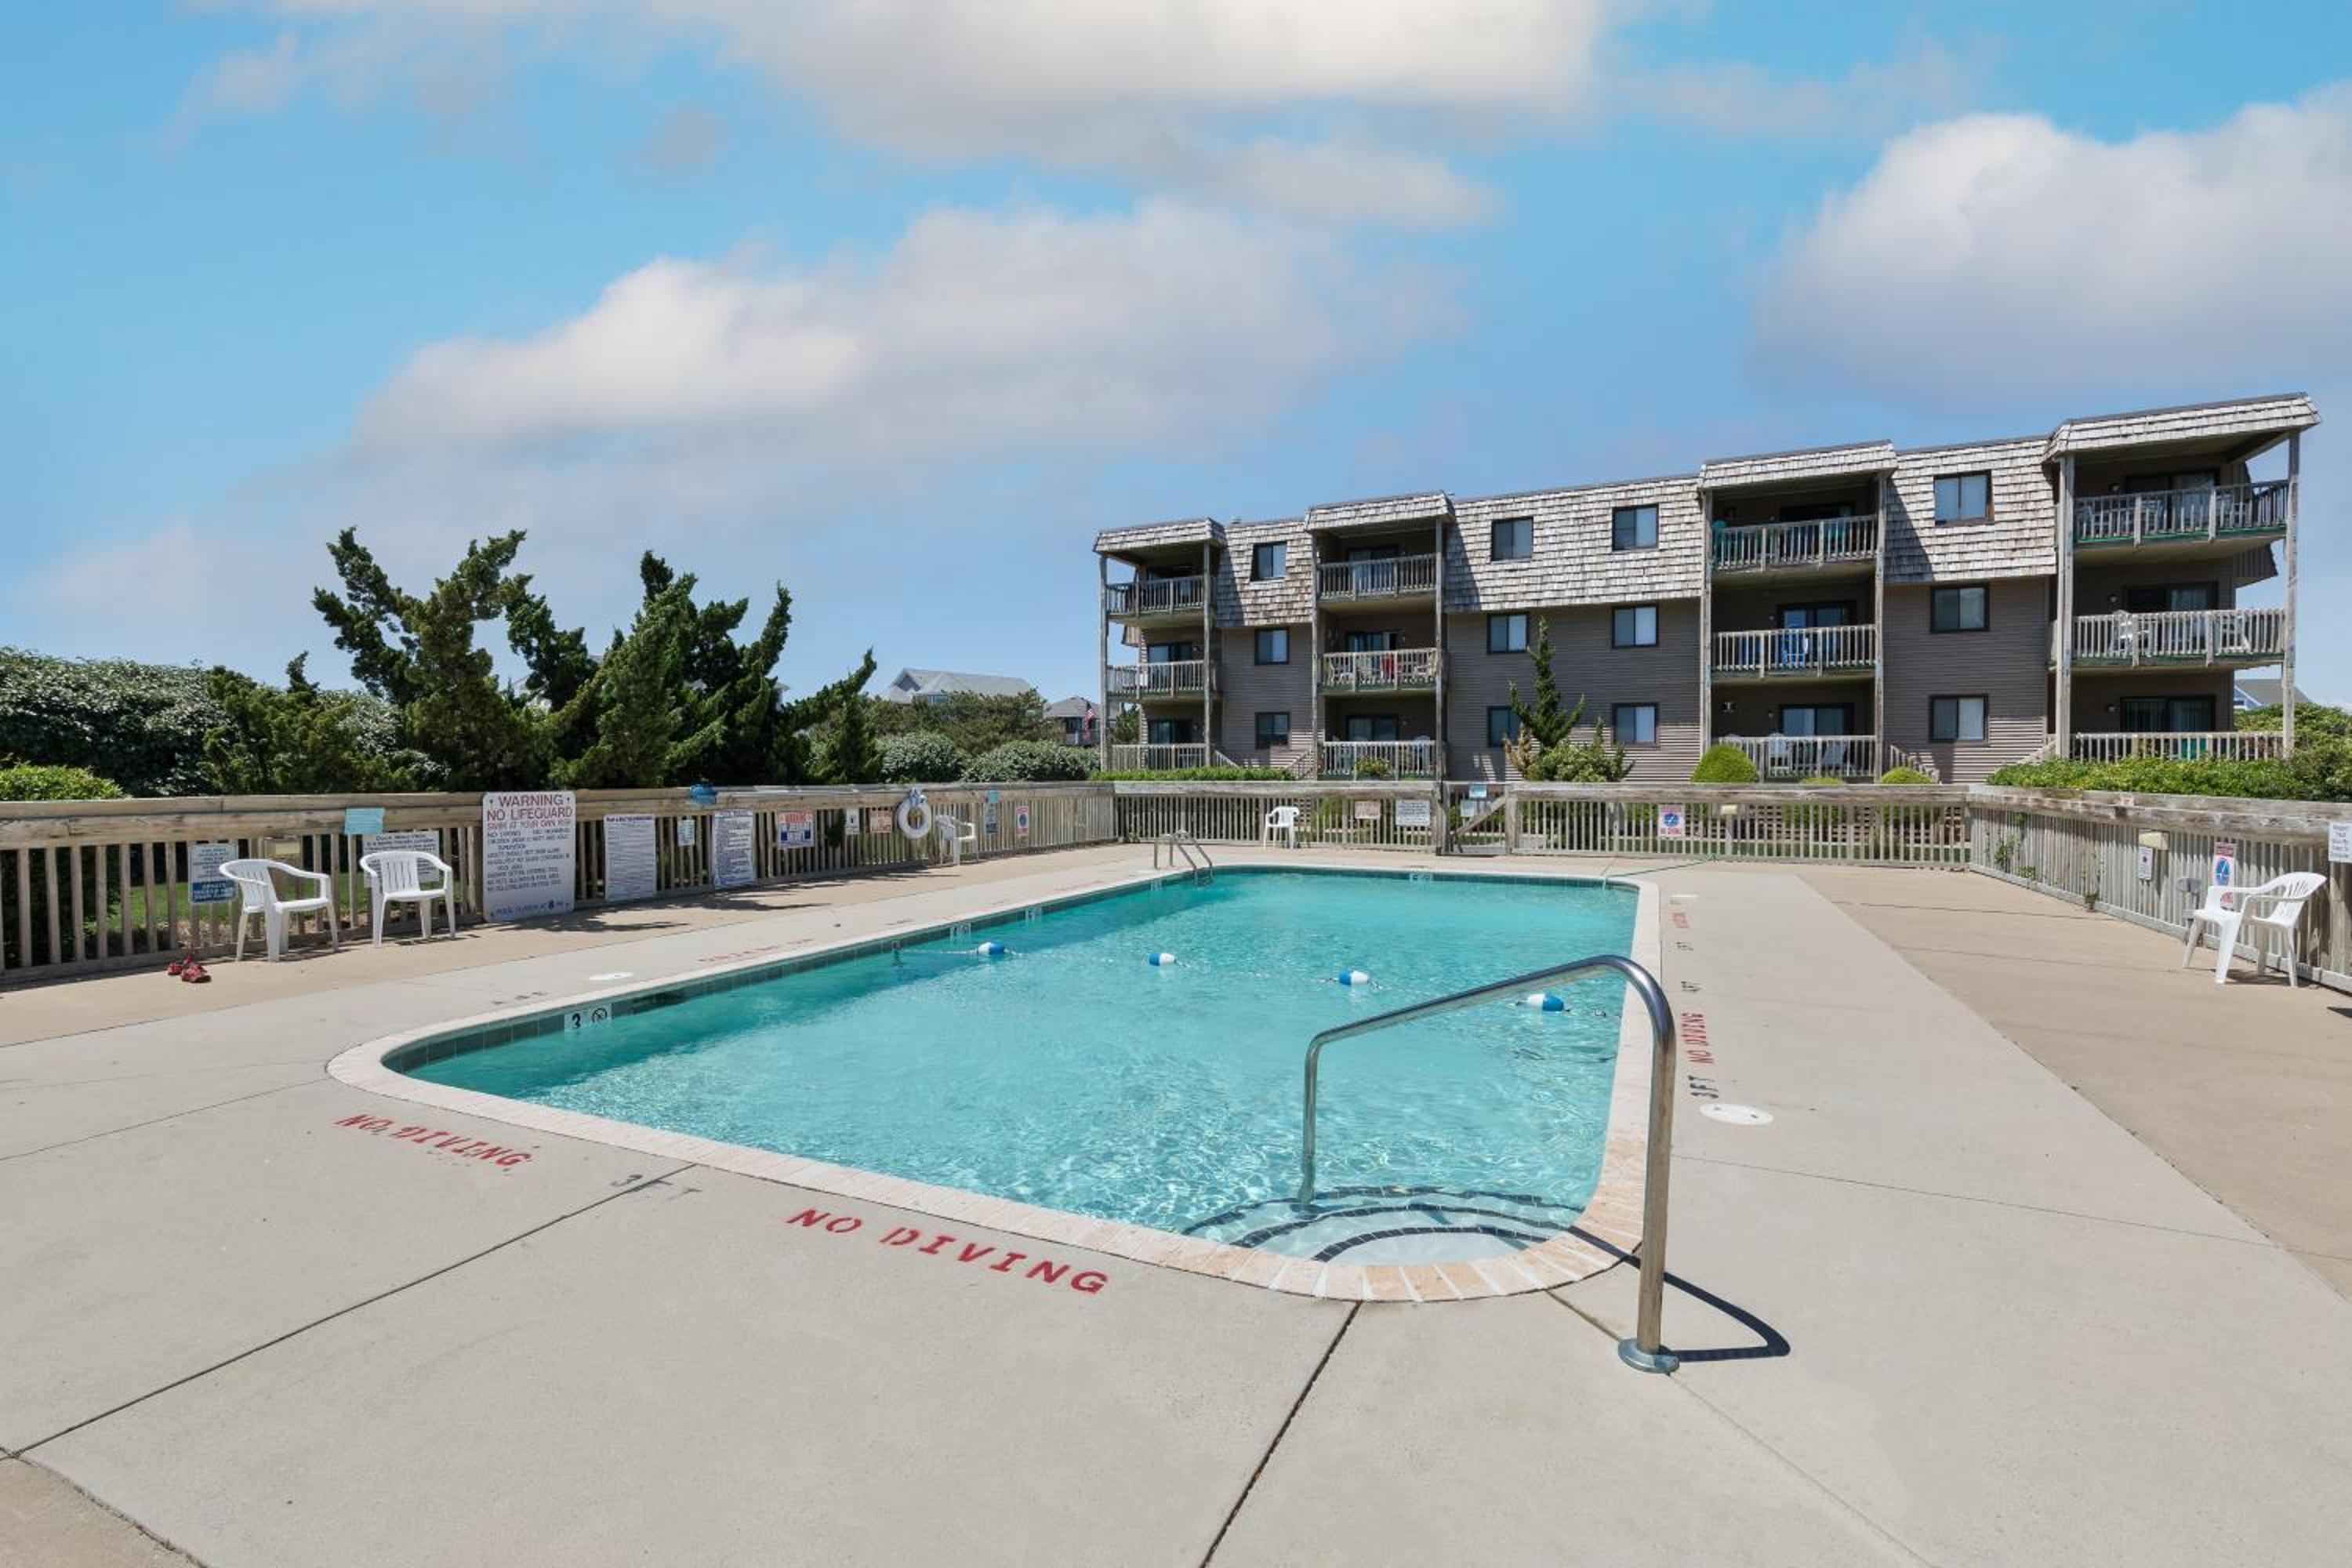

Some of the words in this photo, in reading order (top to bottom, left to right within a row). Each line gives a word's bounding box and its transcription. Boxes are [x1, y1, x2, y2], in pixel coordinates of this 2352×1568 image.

[498, 794, 563, 807] WARNING
[487, 809, 506, 822] NO
[510, 807, 572, 820] LIFEGUARD
[572, 1012, 582, 1029] 3
[332, 1113, 394, 1132] NO
[390, 1126, 532, 1167] DIVING
[785, 1207, 863, 1234] NO
[878, 1226, 1109, 1294] DIVING
